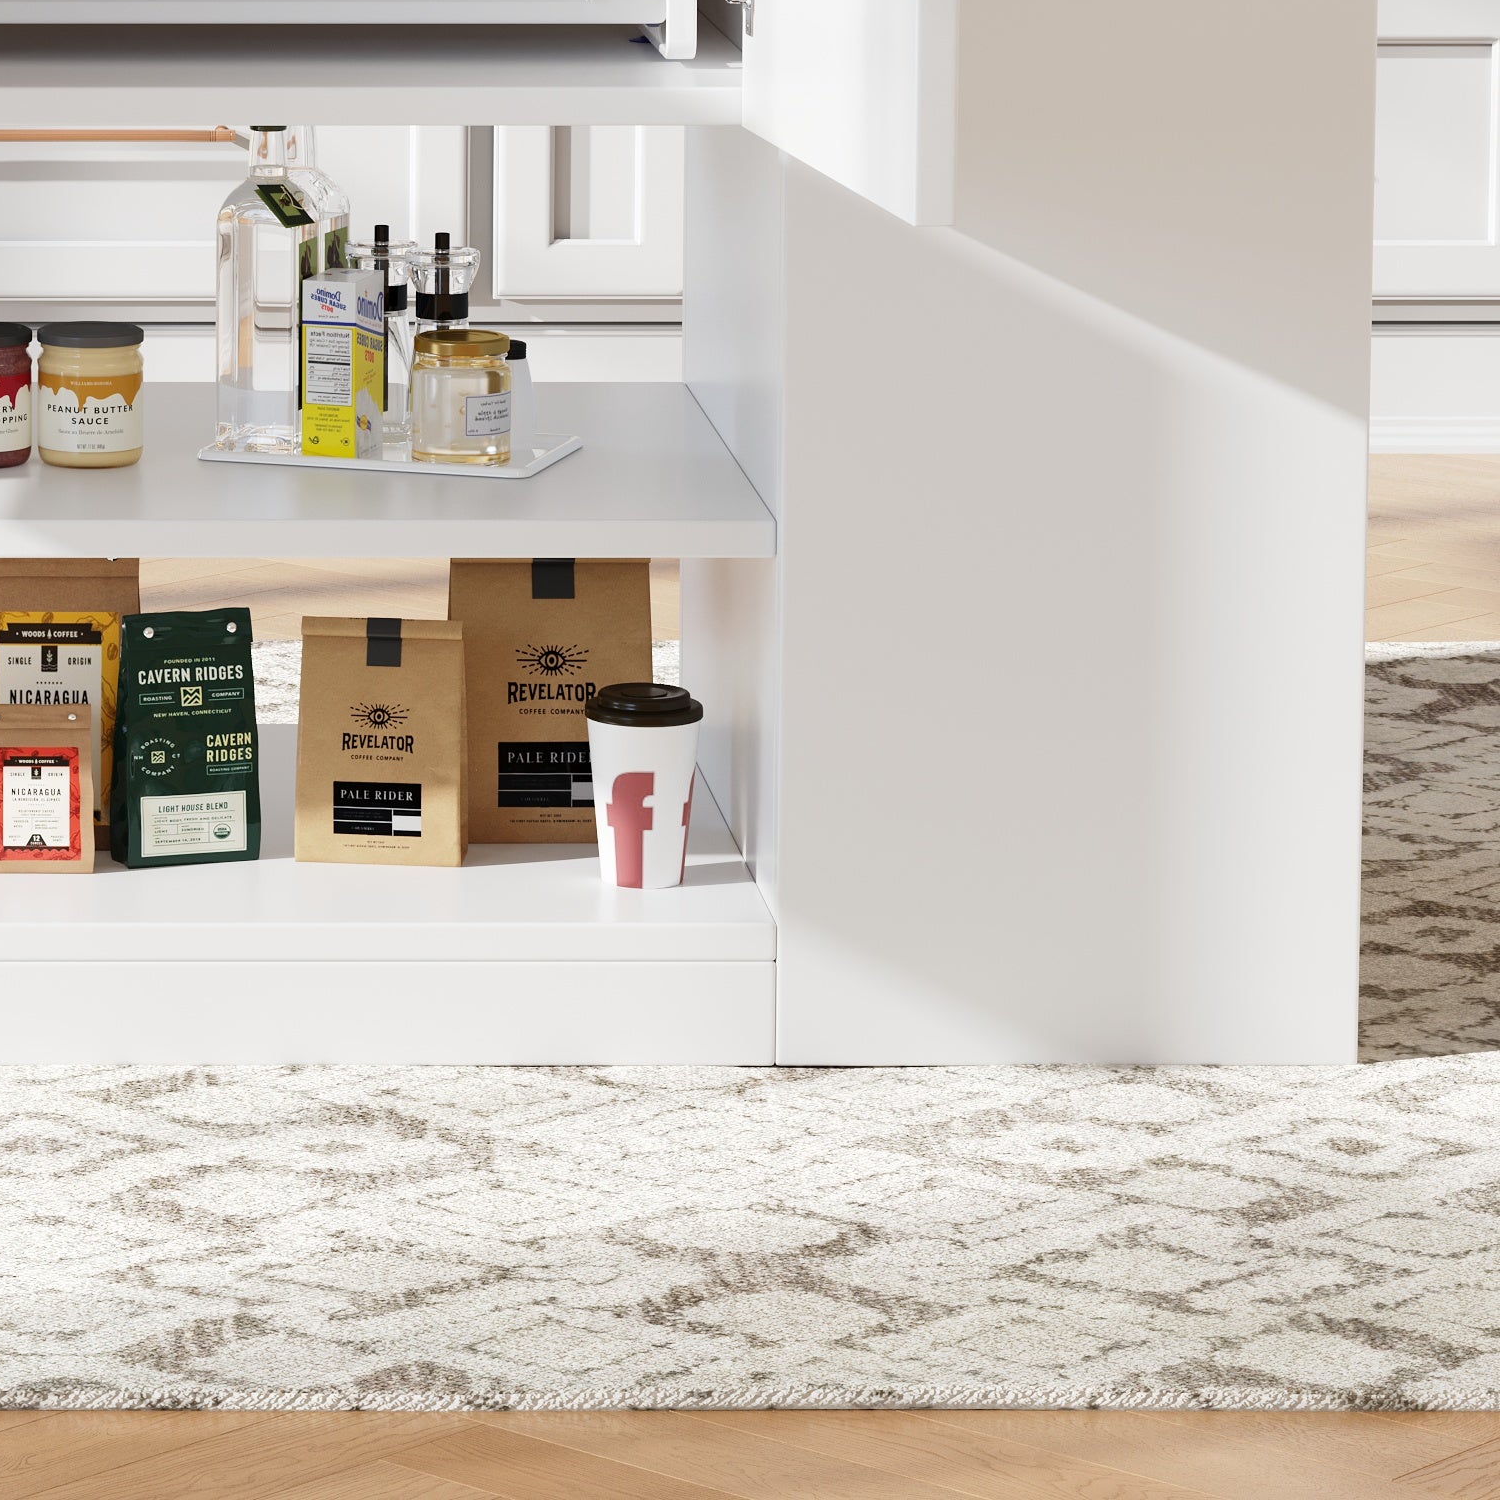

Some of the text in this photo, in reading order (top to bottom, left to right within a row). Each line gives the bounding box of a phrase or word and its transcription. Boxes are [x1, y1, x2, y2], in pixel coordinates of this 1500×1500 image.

[47, 404, 133, 414] PEANUT BUTTER
[71, 417, 109, 425] SAUCE
[21, 630, 78, 638] WOODS COFFEE
[7, 657, 92, 666] SINGLE ORIGIN
[138, 664, 244, 685] CAVERN RIDGES
[9, 689, 89, 705] NICARAGUA
[507, 682, 596, 704] REVELATOR
[140, 738, 175, 750] ROASTING
[206, 732, 252, 747] CAVERN
[342, 732, 414, 754] REVELATOR
[206, 747, 252, 762] RIDGES
[508, 751, 591, 764] PALE RIDE
[141, 765, 175, 777] COMPANY
[11, 788, 62, 796] NICARAGUA
[340, 789, 413, 801] PALE RIDER
[158, 801, 228, 813] LIGHT HOUSE BLEND
